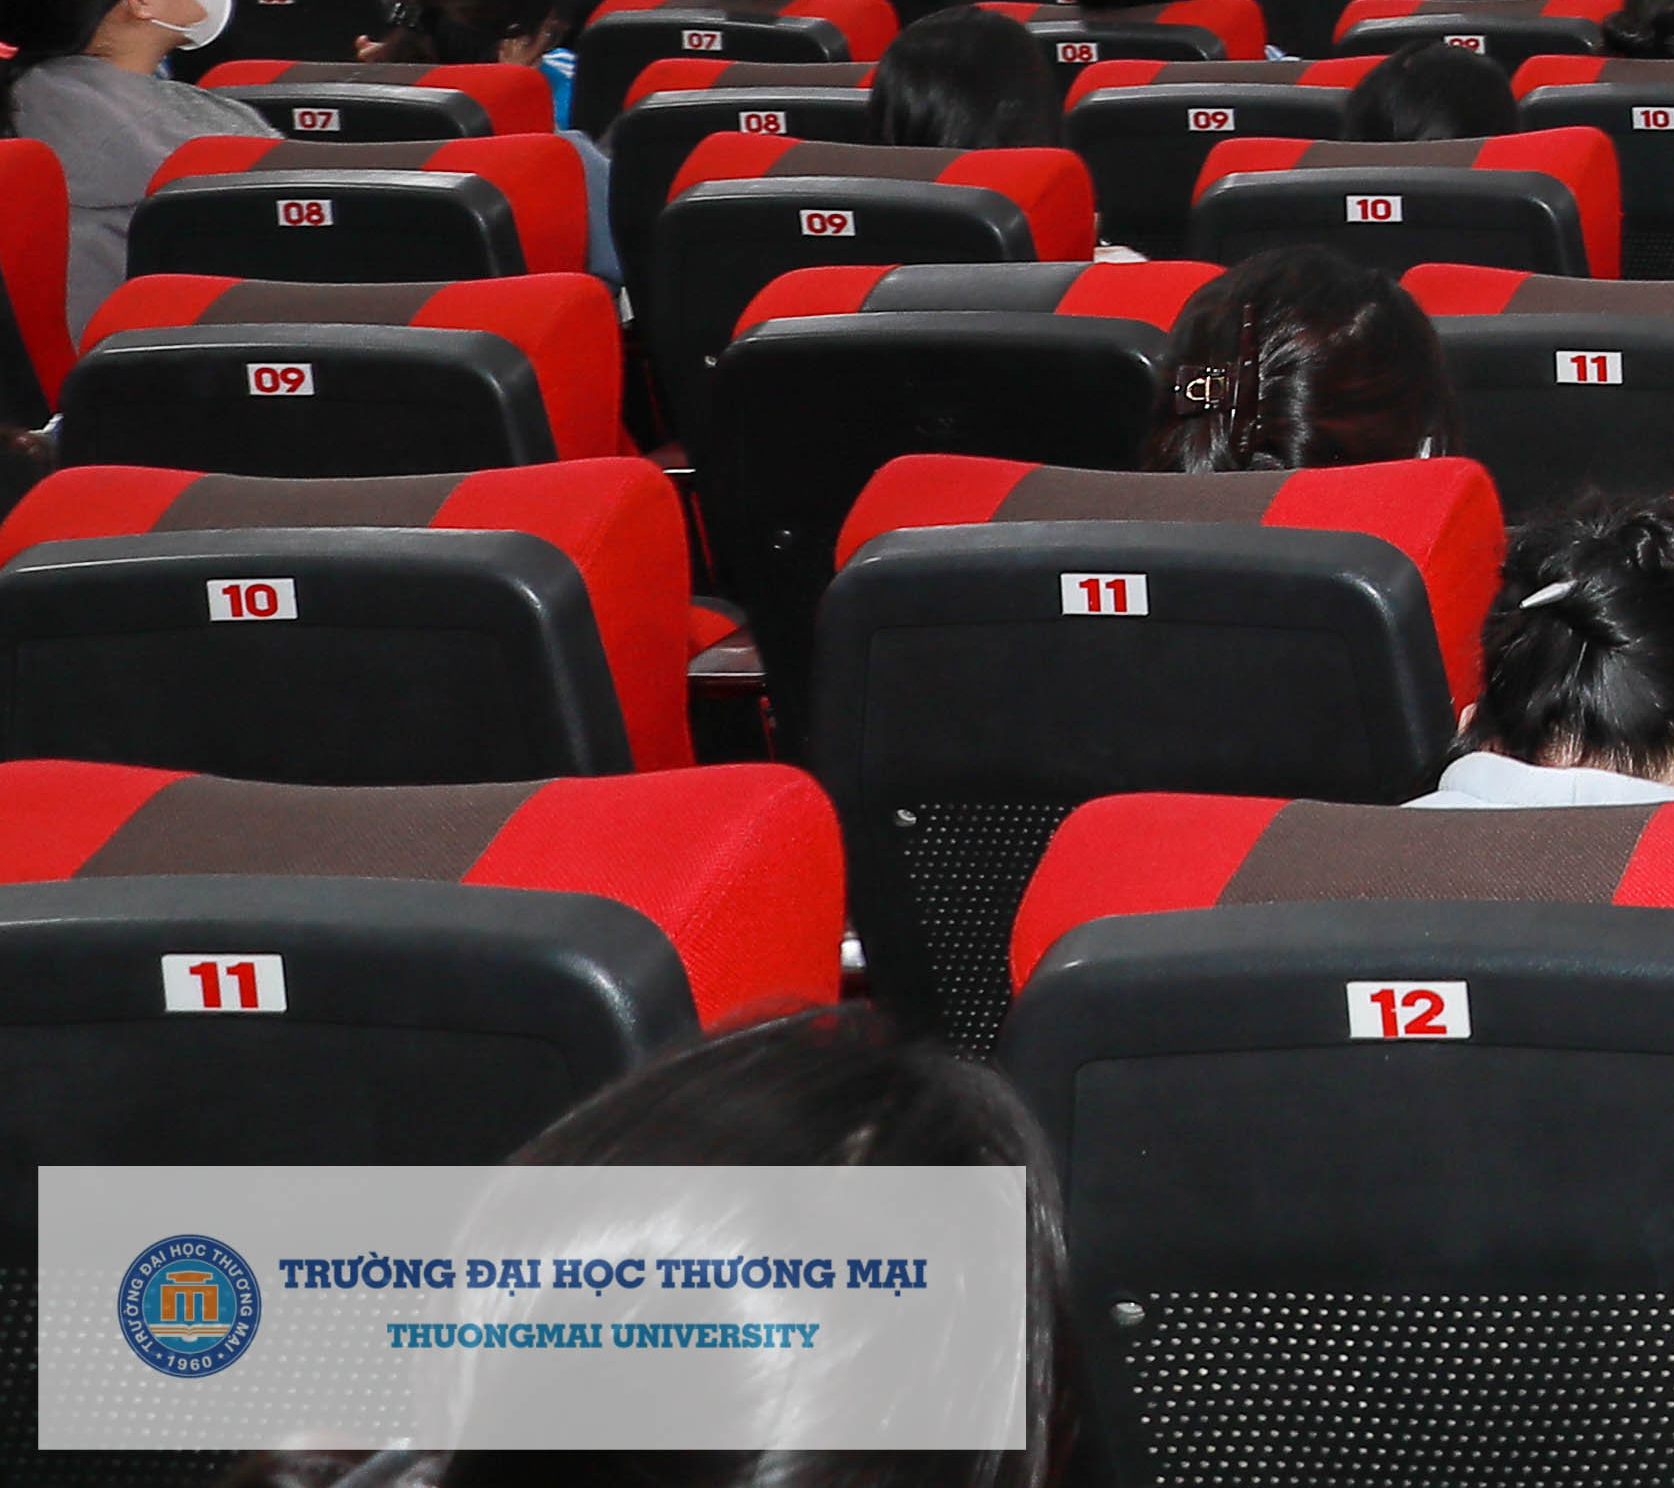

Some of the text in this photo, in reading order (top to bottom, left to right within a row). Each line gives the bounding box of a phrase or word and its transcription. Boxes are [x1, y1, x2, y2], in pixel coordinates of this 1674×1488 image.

[687, 32, 718, 50] 07
[1062, 44, 1094, 63] 08
[299, 111, 333, 129] 07
[745, 114, 780, 133] 08
[1193, 111, 1229, 129] 09
[1641, 110, 1670, 129] 10
[283, 201, 326, 226] 08
[1357, 198, 1392, 221] 10
[807, 212, 848, 235] 09
[1571, 355, 1607, 382] 11
[254, 367, 305, 394] 09
[222, 584, 278, 618] 10
[1079, 578, 1127, 613] 11
[189, 961, 259, 1009] 11
[1370, 988, 1447, 1038] 12
